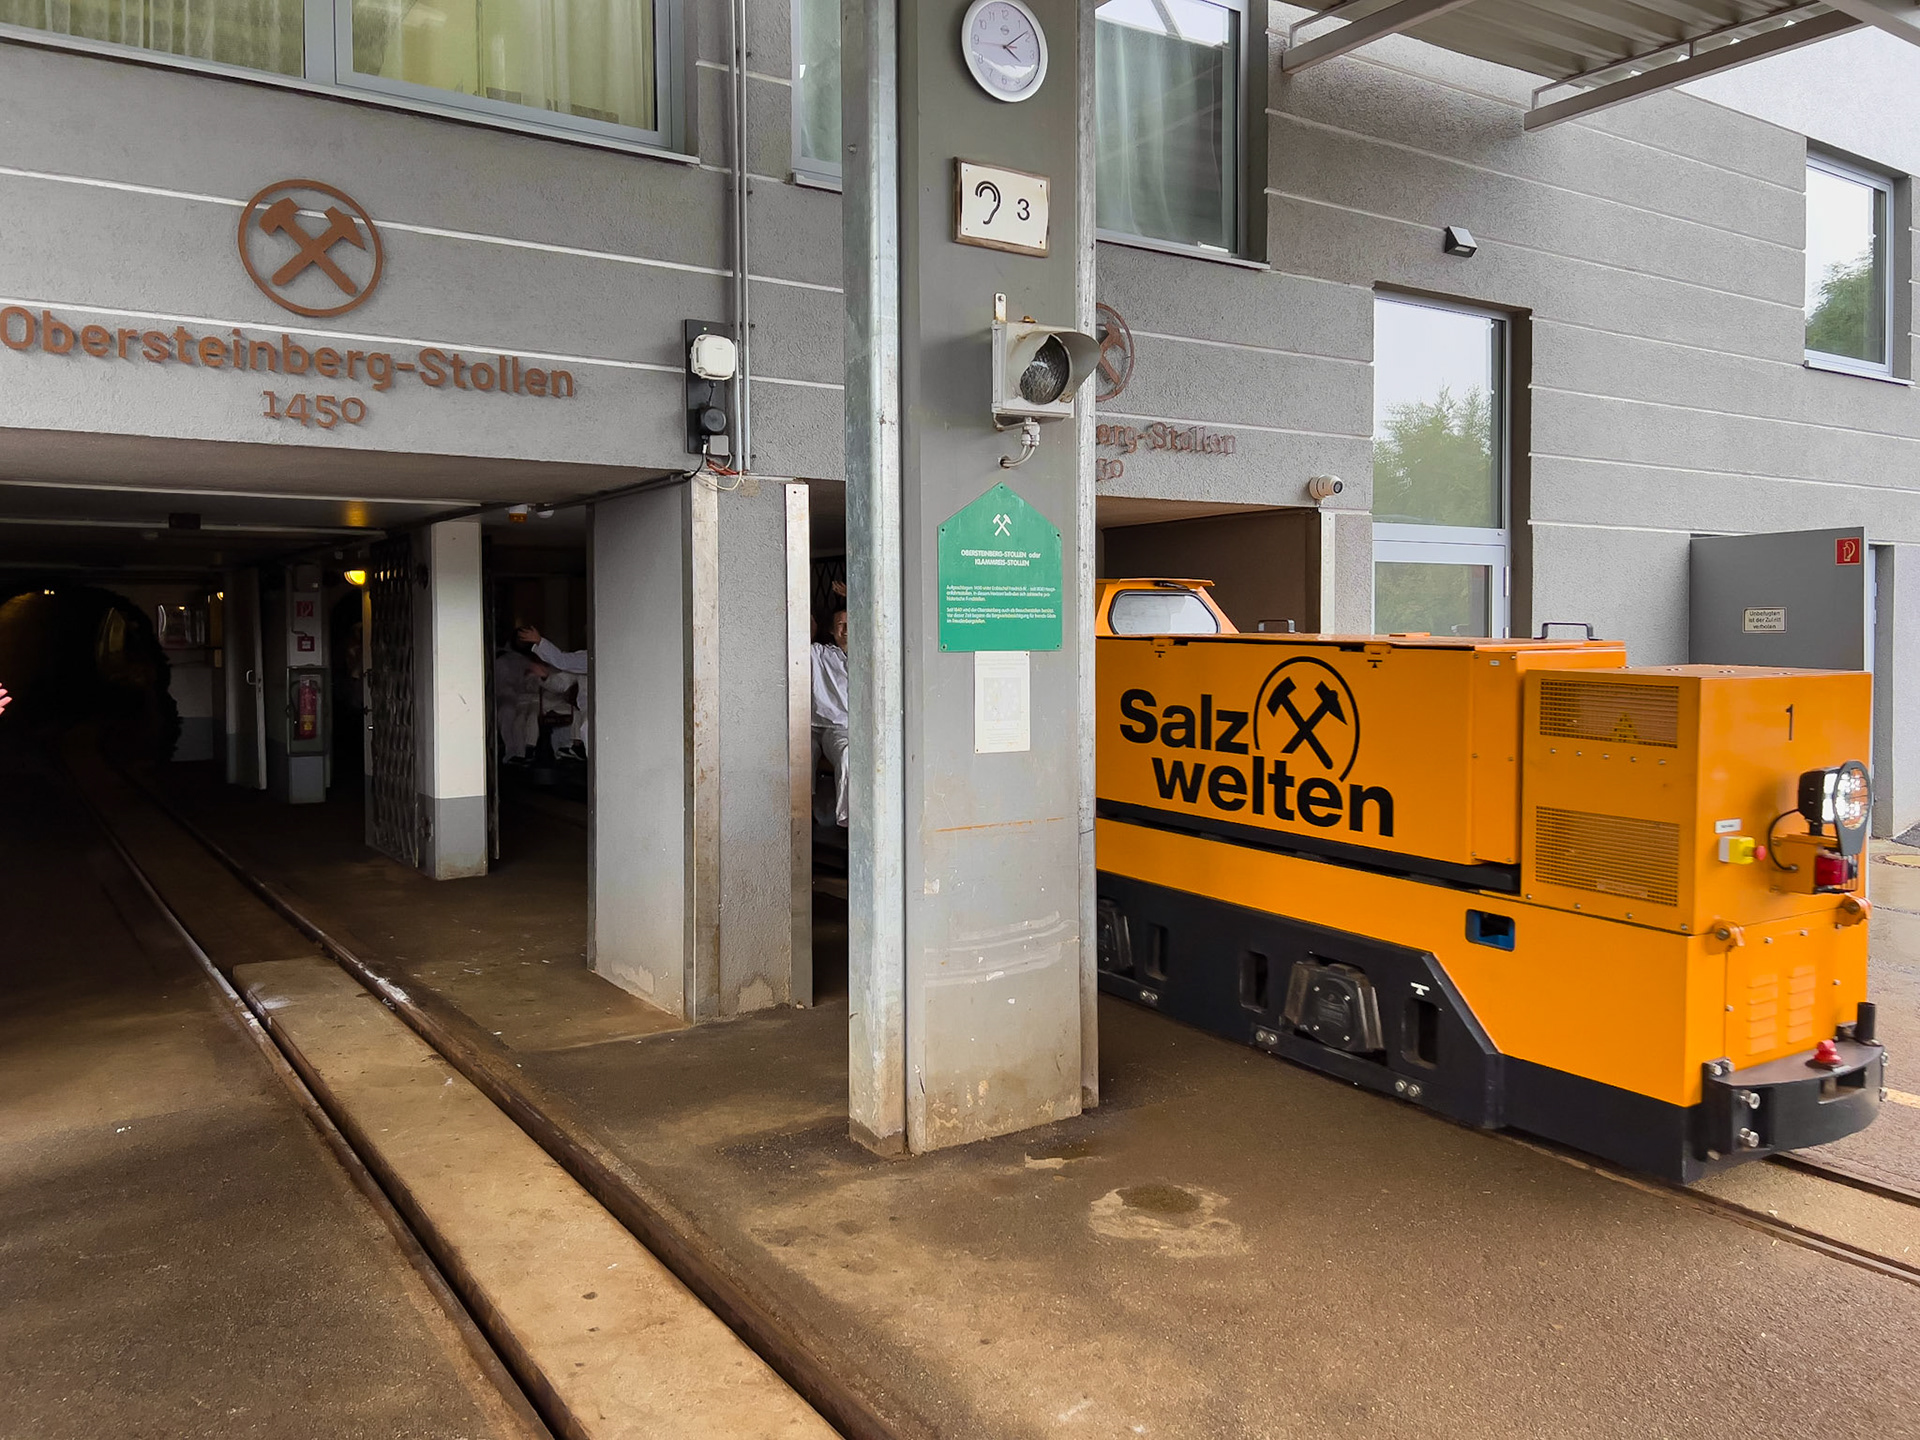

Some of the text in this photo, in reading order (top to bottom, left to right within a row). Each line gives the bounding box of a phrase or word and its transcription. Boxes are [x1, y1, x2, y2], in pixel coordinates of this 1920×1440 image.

[979, 19, 987, 30] 10
[1001, 9, 1009, 21] 12
[1017, 198, 1030, 221] 3
[1, 306, 575, 399] Obersteinberg-Stollen
[262, 390, 367, 429] 1450
[1096, 422, 1236, 454] erg-Stollen
[1119, 688, 1249, 755] Salz
[1784, 703, 1794, 741] 1
[1151, 755, 1394, 838] welten
